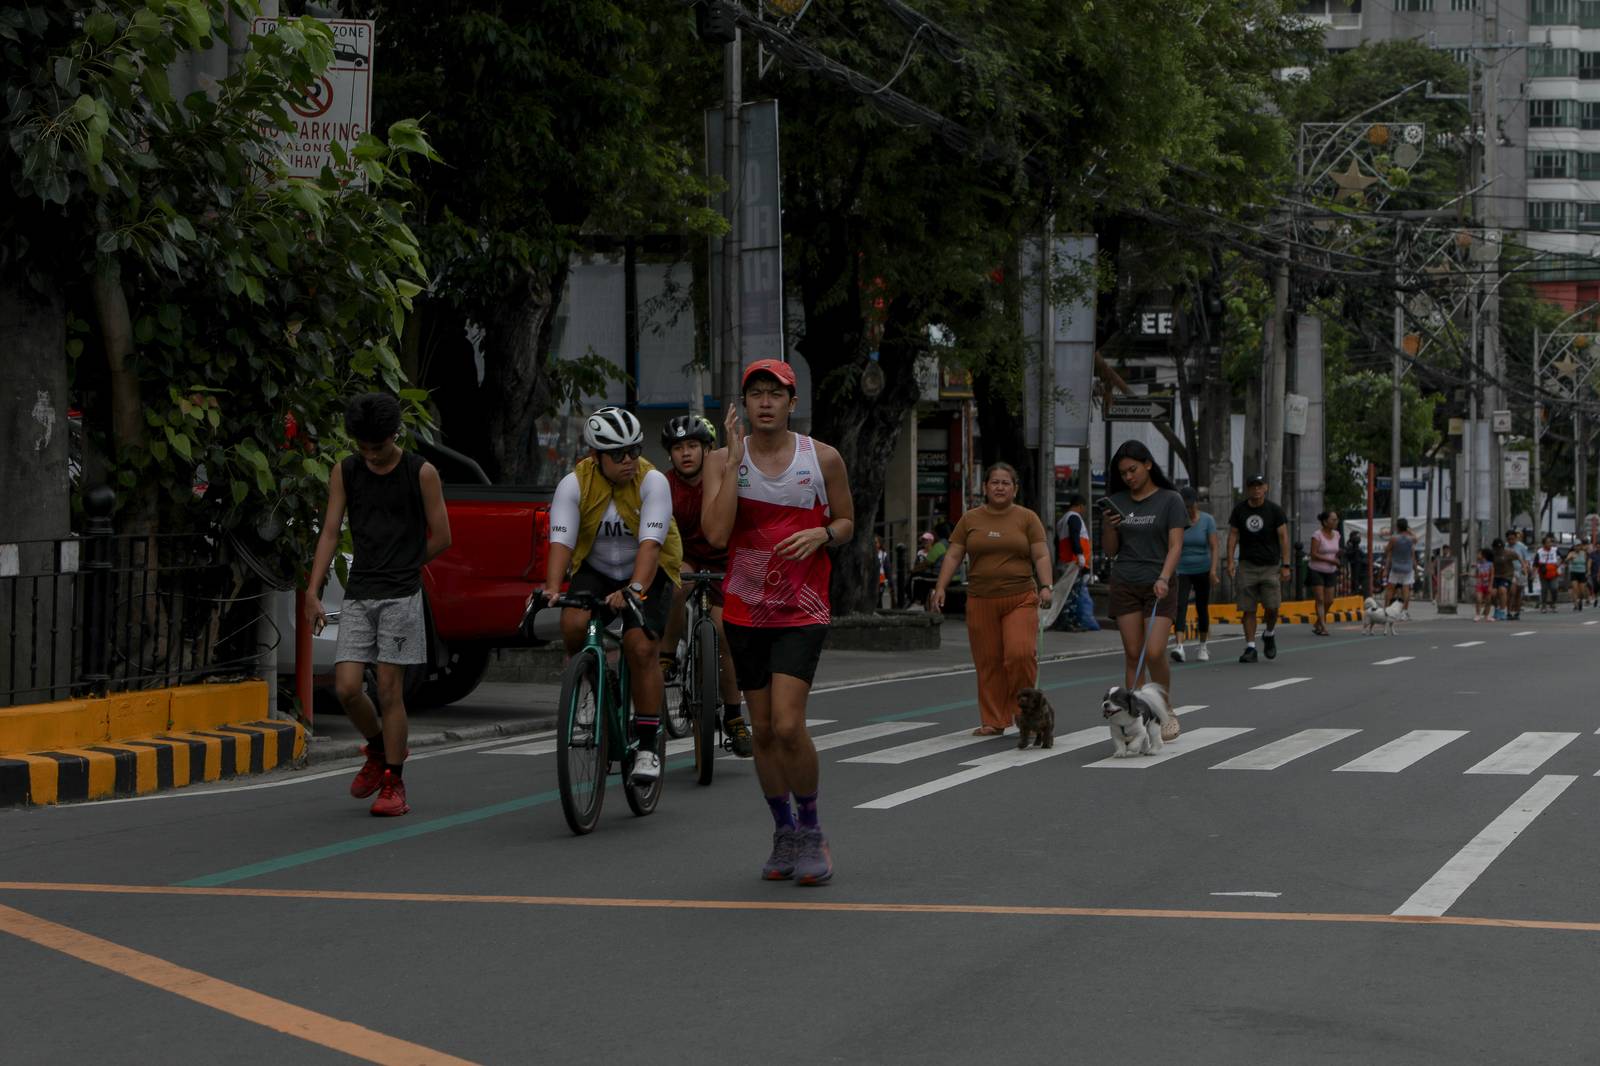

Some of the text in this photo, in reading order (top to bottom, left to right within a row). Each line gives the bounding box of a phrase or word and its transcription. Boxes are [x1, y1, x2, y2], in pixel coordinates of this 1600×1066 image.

[332, 26, 364, 38] ZONE
[286, 142, 332, 152] ALONG
[1132, 407, 1150, 415] WAY
[551, 525, 568, 533] VMS
[646, 521, 664, 529] VMS
